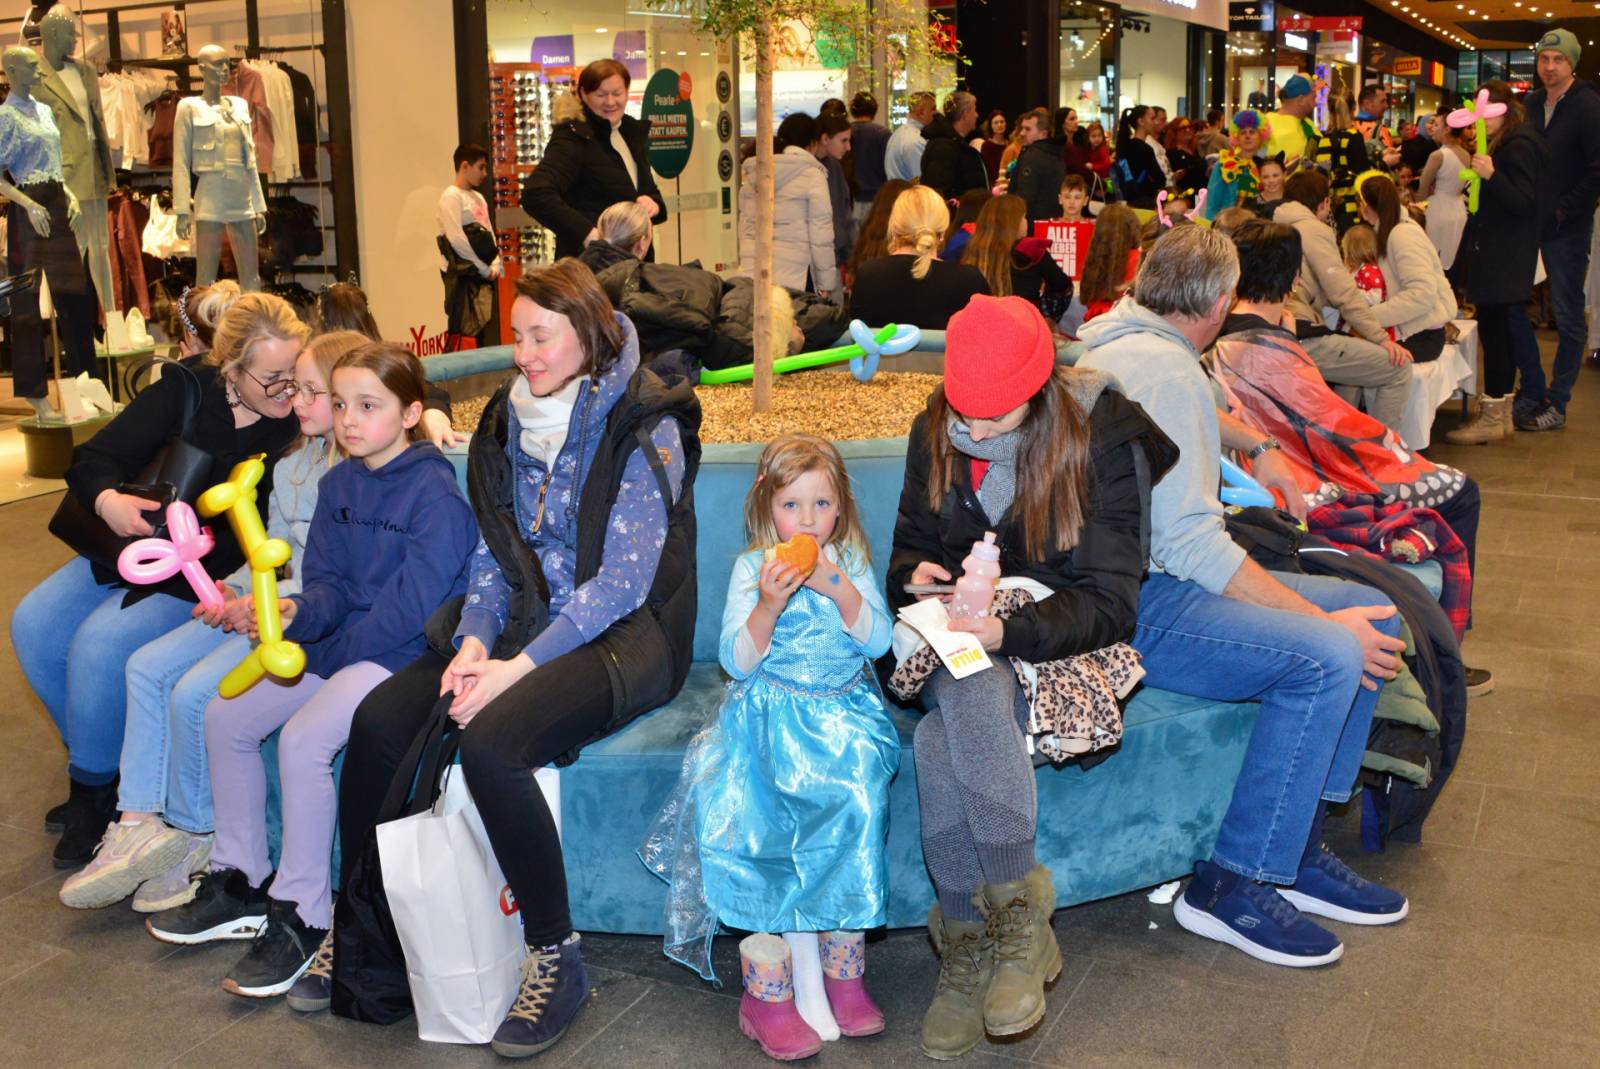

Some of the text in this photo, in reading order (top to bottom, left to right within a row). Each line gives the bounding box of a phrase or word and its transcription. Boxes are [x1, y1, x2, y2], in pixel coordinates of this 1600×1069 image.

[542, 55, 570, 65] Damen
[654, 94, 674, 106] Pearle
[1047, 226, 1077, 242] ALLE
